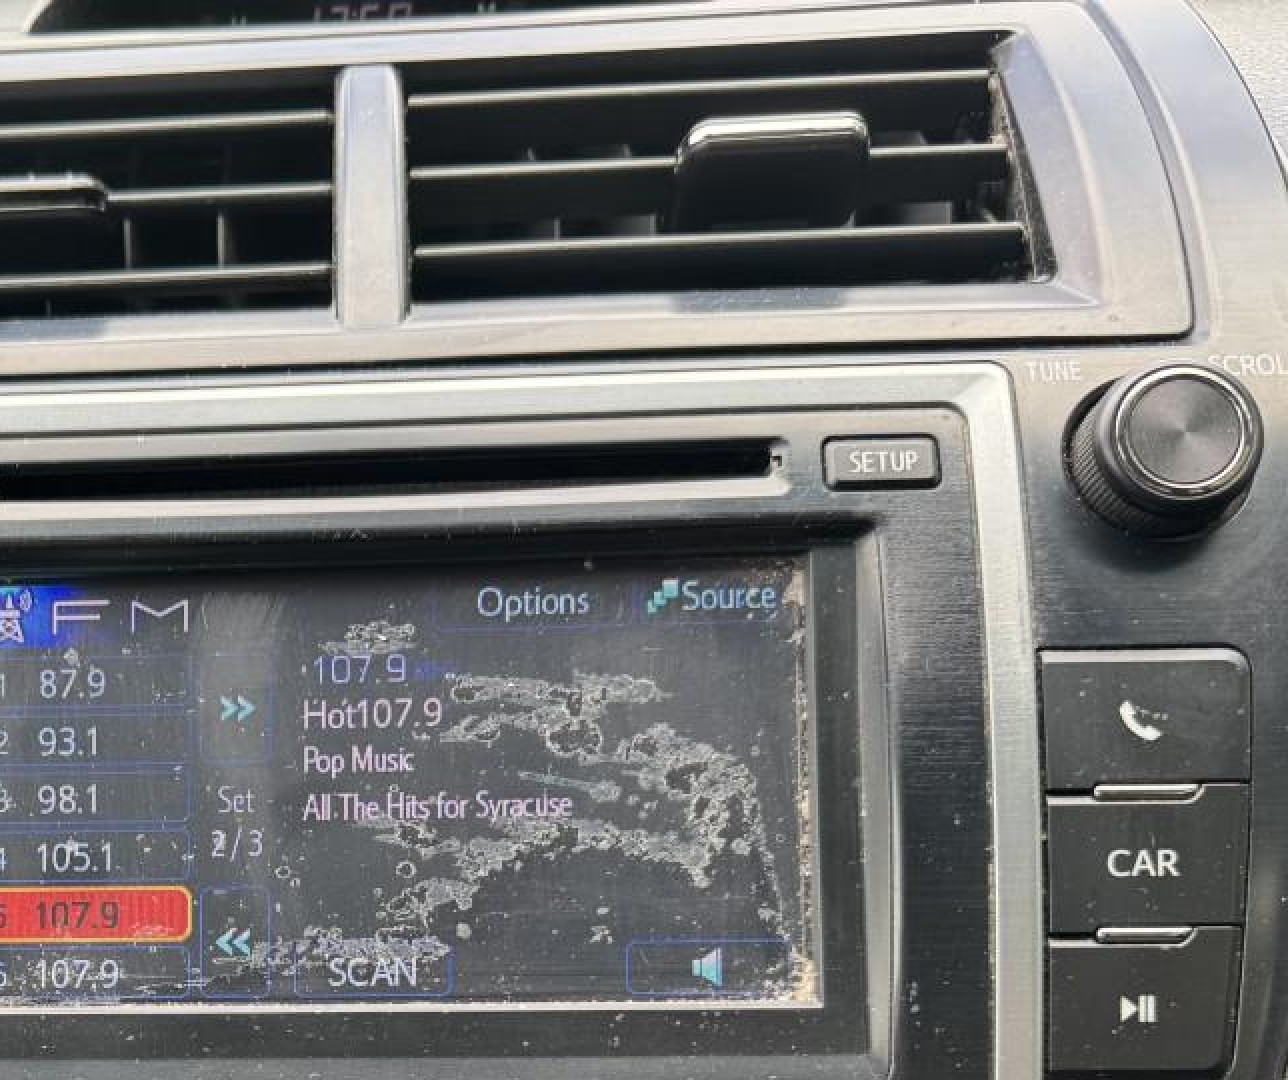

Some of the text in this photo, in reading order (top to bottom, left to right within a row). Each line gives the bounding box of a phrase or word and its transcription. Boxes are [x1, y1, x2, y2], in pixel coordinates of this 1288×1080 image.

[1026, 361, 1081, 382] TUNE
[849, 451, 919, 473] SETUP
[477, 586, 590, 622] Options
[681, 580, 776, 609] Source
[39, 668, 107, 699] 87.9
[313, 654, 408, 684] 107.9
[302, 698, 442, 729] Hot107.9
[38, 726, 98, 756] 93.1
[302, 745, 415, 778] Pop Music
[37, 783, 97, 814] 98.1
[217, 785, 255, 813] Set
[302, 790, 574, 823] All The Hits for Syracuse
[37, 841, 112, 873] 105.1
[1106, 849, 1181, 877] CAR
[35, 901, 121, 929] 107.9
[37, 959, 120, 989] 107.9
[327, 957, 418, 987] SCAN
